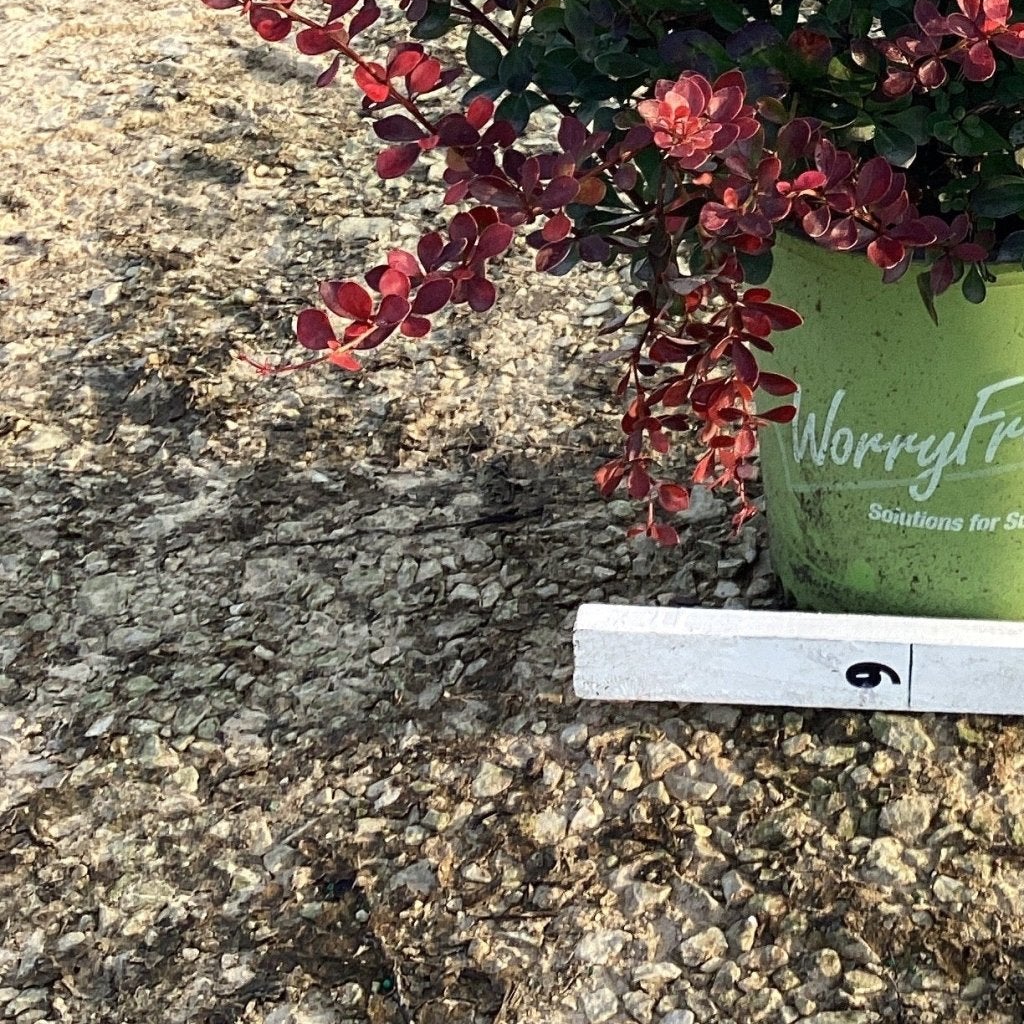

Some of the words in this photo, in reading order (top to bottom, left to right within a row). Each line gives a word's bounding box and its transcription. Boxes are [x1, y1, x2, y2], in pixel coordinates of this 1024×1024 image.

[868, 502, 964, 532] Solutions
[968, 513, 1001, 532] for
[845, 661, 901, 689] 6
